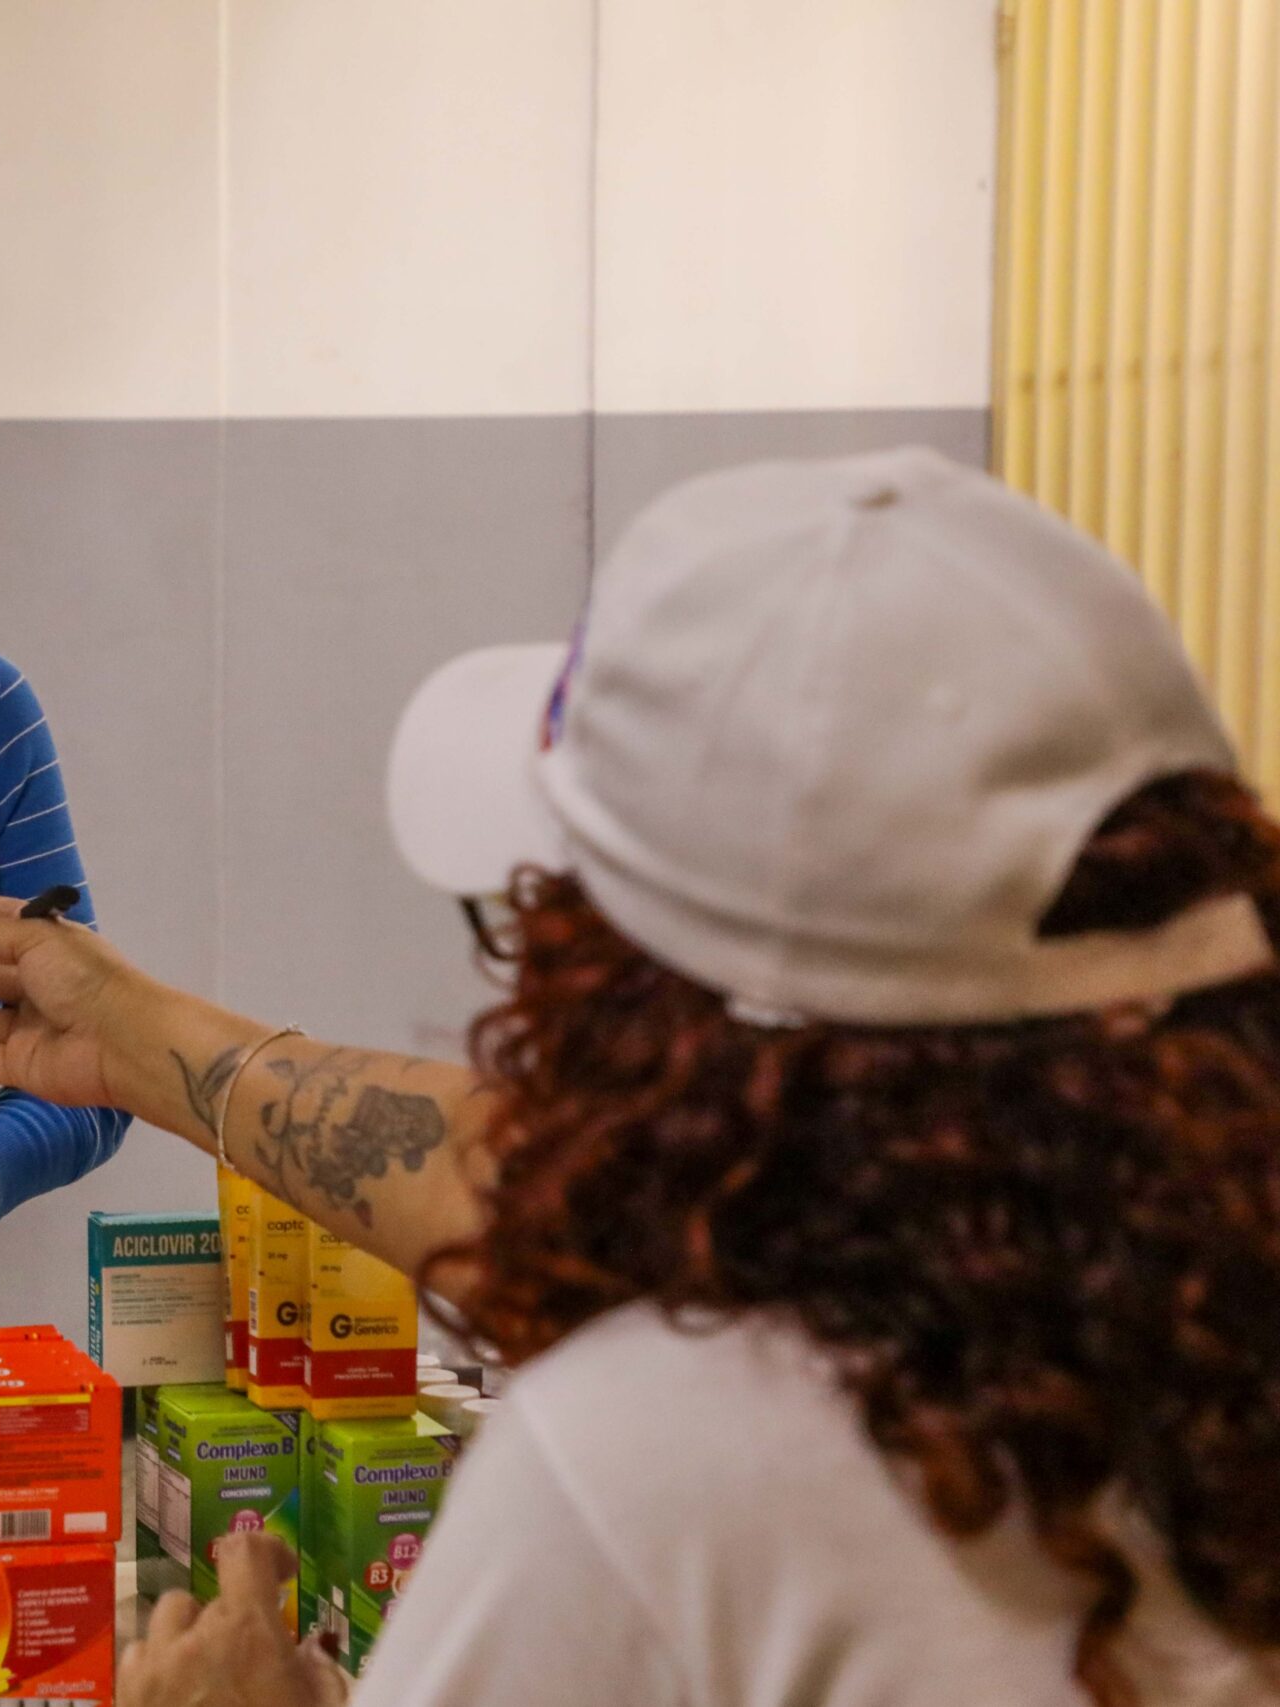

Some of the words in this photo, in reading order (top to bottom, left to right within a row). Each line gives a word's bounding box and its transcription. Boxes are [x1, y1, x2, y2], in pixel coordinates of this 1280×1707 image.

[112, 1232, 195, 1258] ACICLOVIR
[196, 1440, 275, 1461] Complexo
[277, 1437, 295, 1454] B
[223, 1466, 267, 1481] IMUNO
[354, 1463, 439, 1485] Complexo
[383, 1490, 427, 1505] IMUNO
[392, 1543, 421, 1559] B12
[370, 1569, 389, 1584] B3
